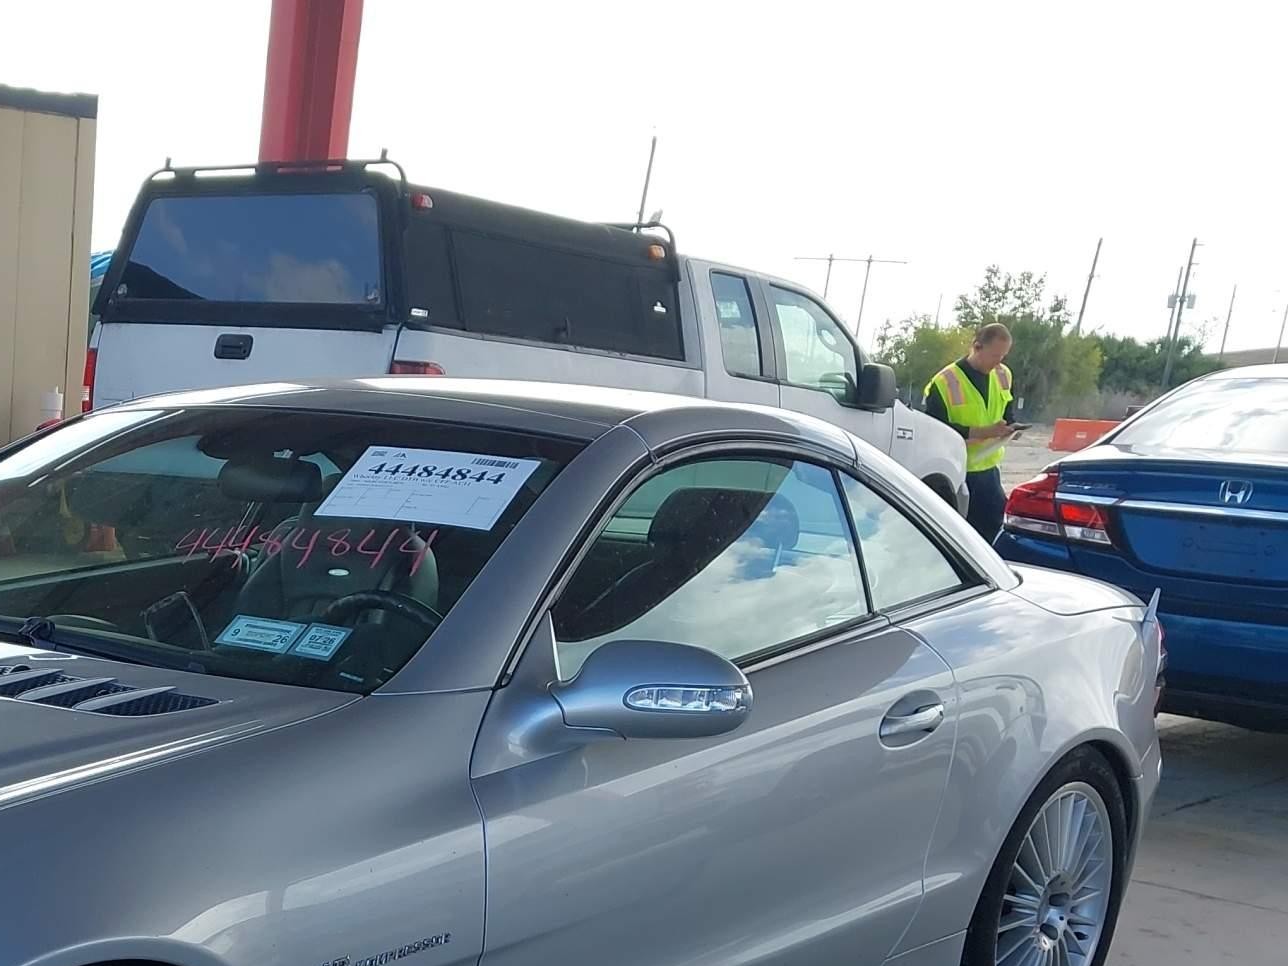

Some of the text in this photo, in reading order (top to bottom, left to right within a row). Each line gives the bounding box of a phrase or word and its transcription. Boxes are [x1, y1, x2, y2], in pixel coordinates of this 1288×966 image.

[368, 462, 506, 485] 44484844
[176, 525, 438, 577] 44484844
[231, 628, 241, 637] 9
[272, 634, 290, 645] 26
